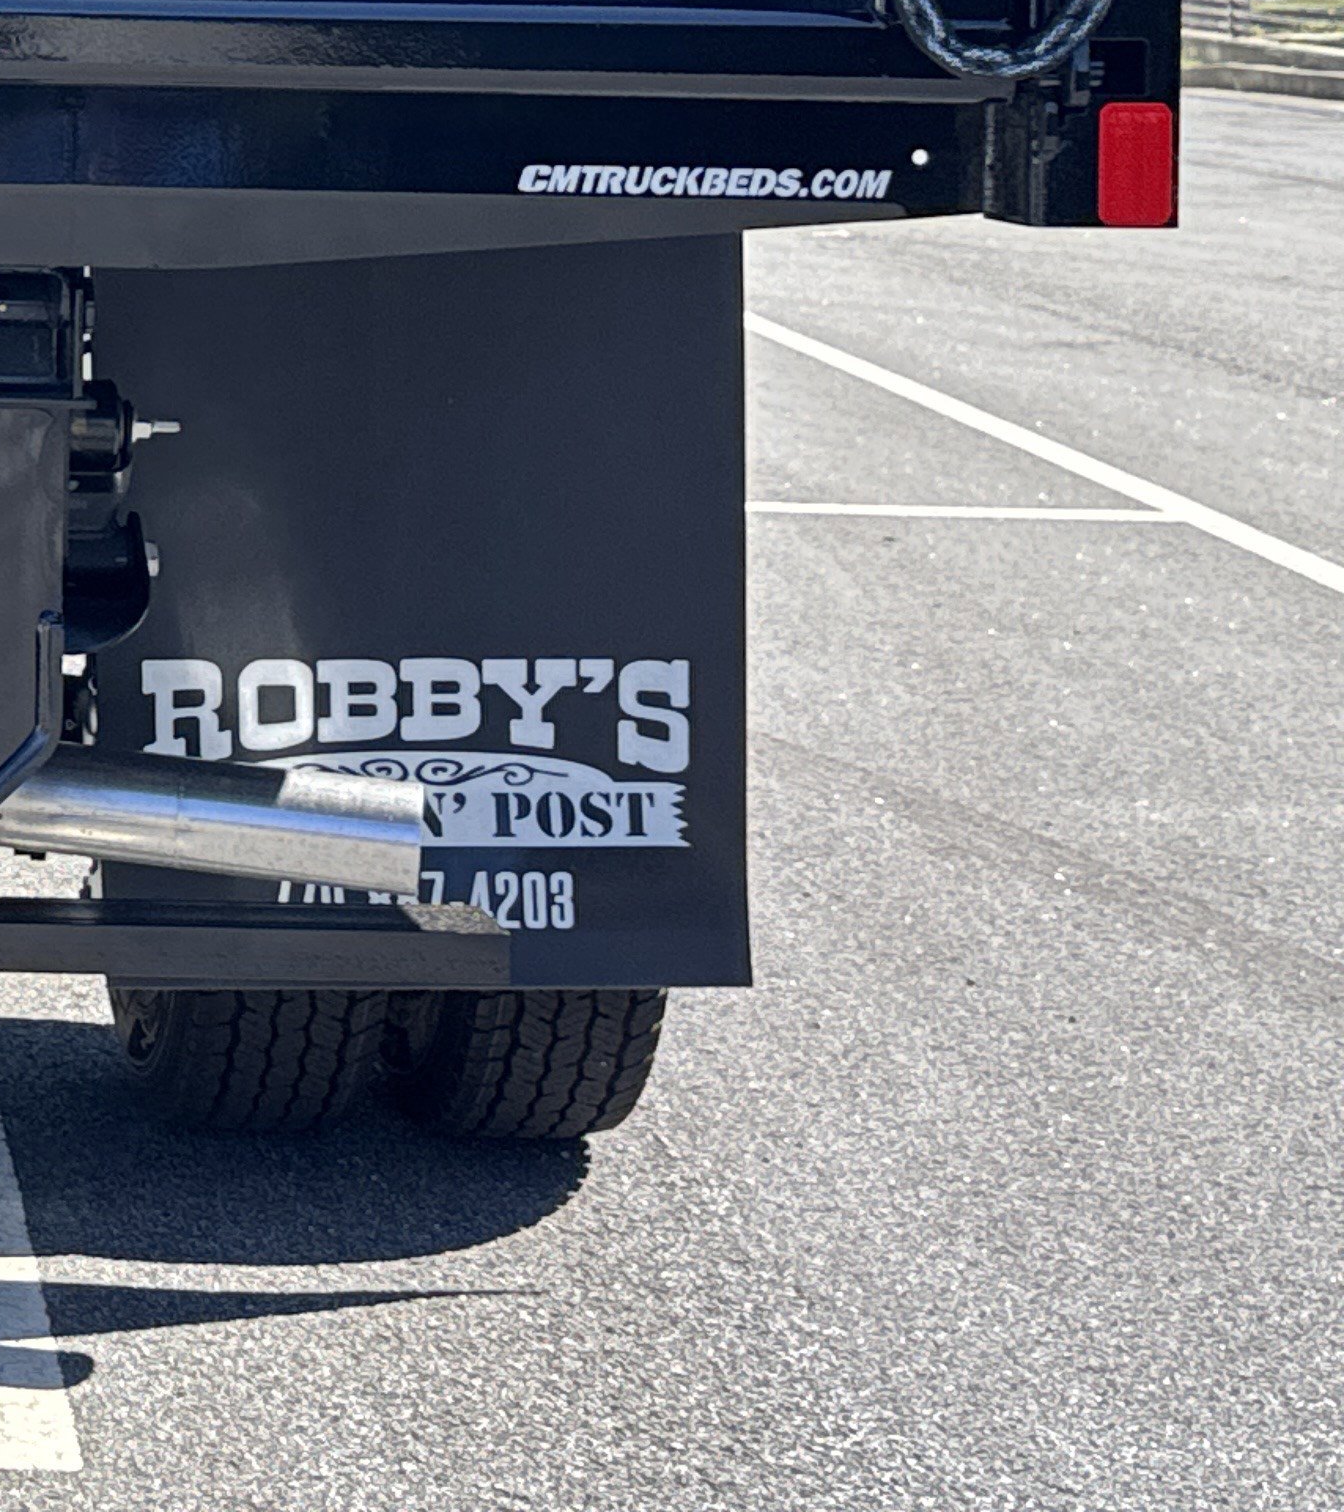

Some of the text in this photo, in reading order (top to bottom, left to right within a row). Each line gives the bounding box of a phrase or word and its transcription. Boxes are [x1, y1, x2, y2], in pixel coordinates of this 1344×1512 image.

[518, 164, 892, 199] CMTRUCKBEDS.COM
[140, 657, 691, 773] ROBBY'S
[491, 791, 655, 839] POST
